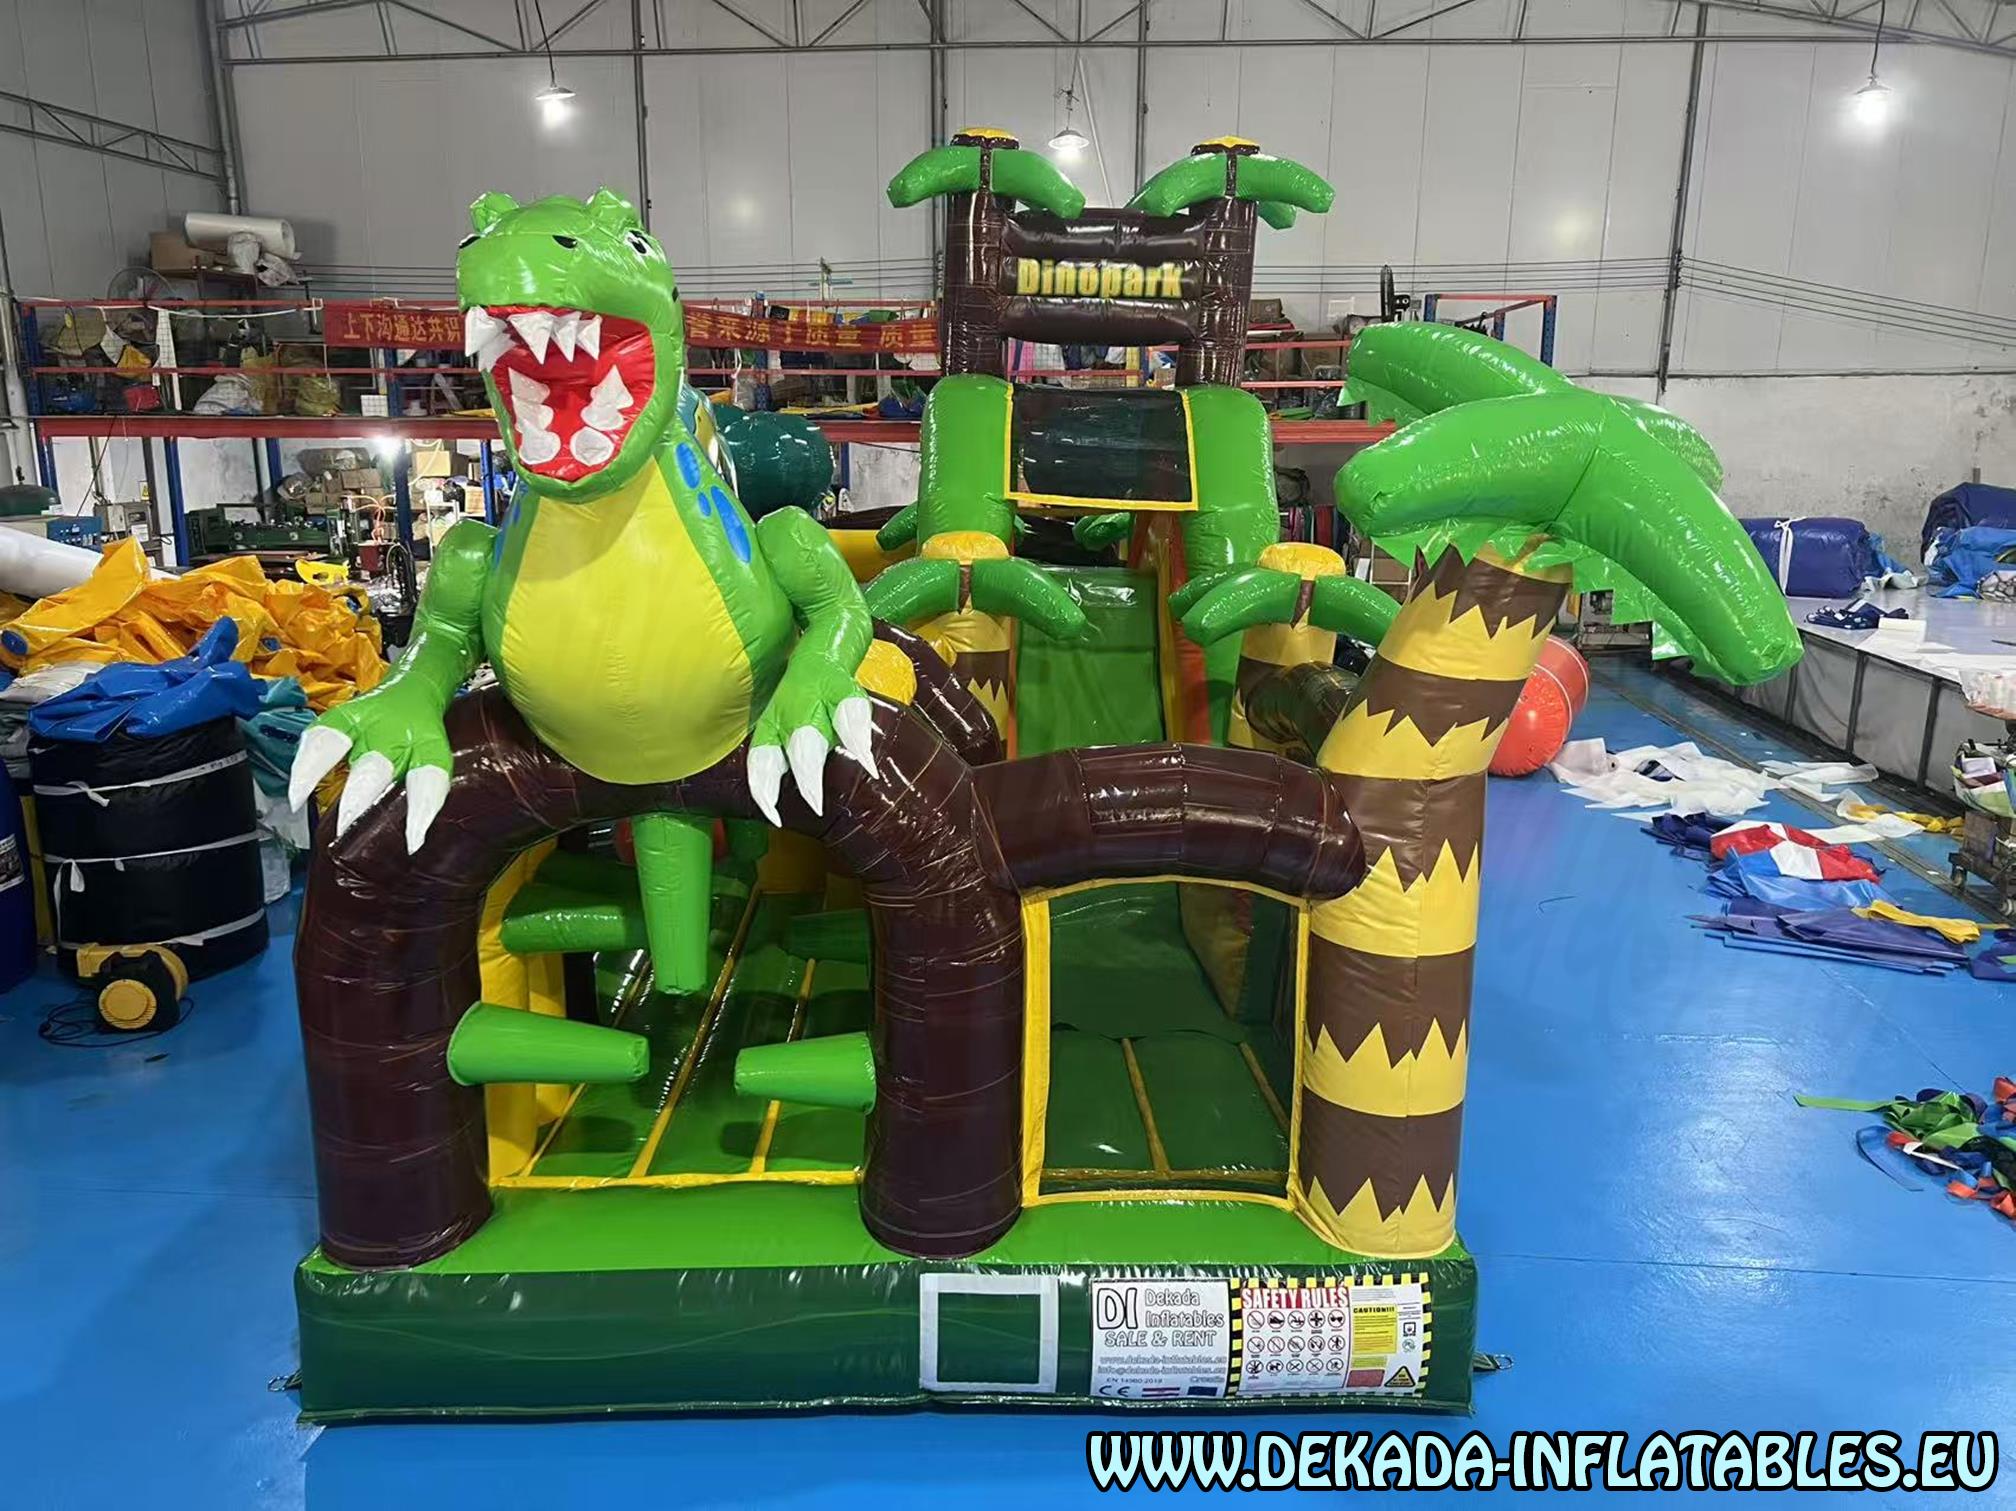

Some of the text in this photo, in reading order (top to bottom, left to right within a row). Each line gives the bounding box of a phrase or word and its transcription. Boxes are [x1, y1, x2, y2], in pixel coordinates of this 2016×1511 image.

[1017, 257, 1183, 299] Dinopark
[343, 312, 460, 342] 上下沟通达共识
[1097, 1287, 1138, 1330] DI
[1144, 1288, 1200, 1306] Dekada
[1241, 1287, 1298, 1310] SAFETY
[1301, 1285, 1349, 1309] RULES
[1145, 1309, 1225, 1328] Inflatables
[1104, 1330, 1217, 1347] SALE & RENT
